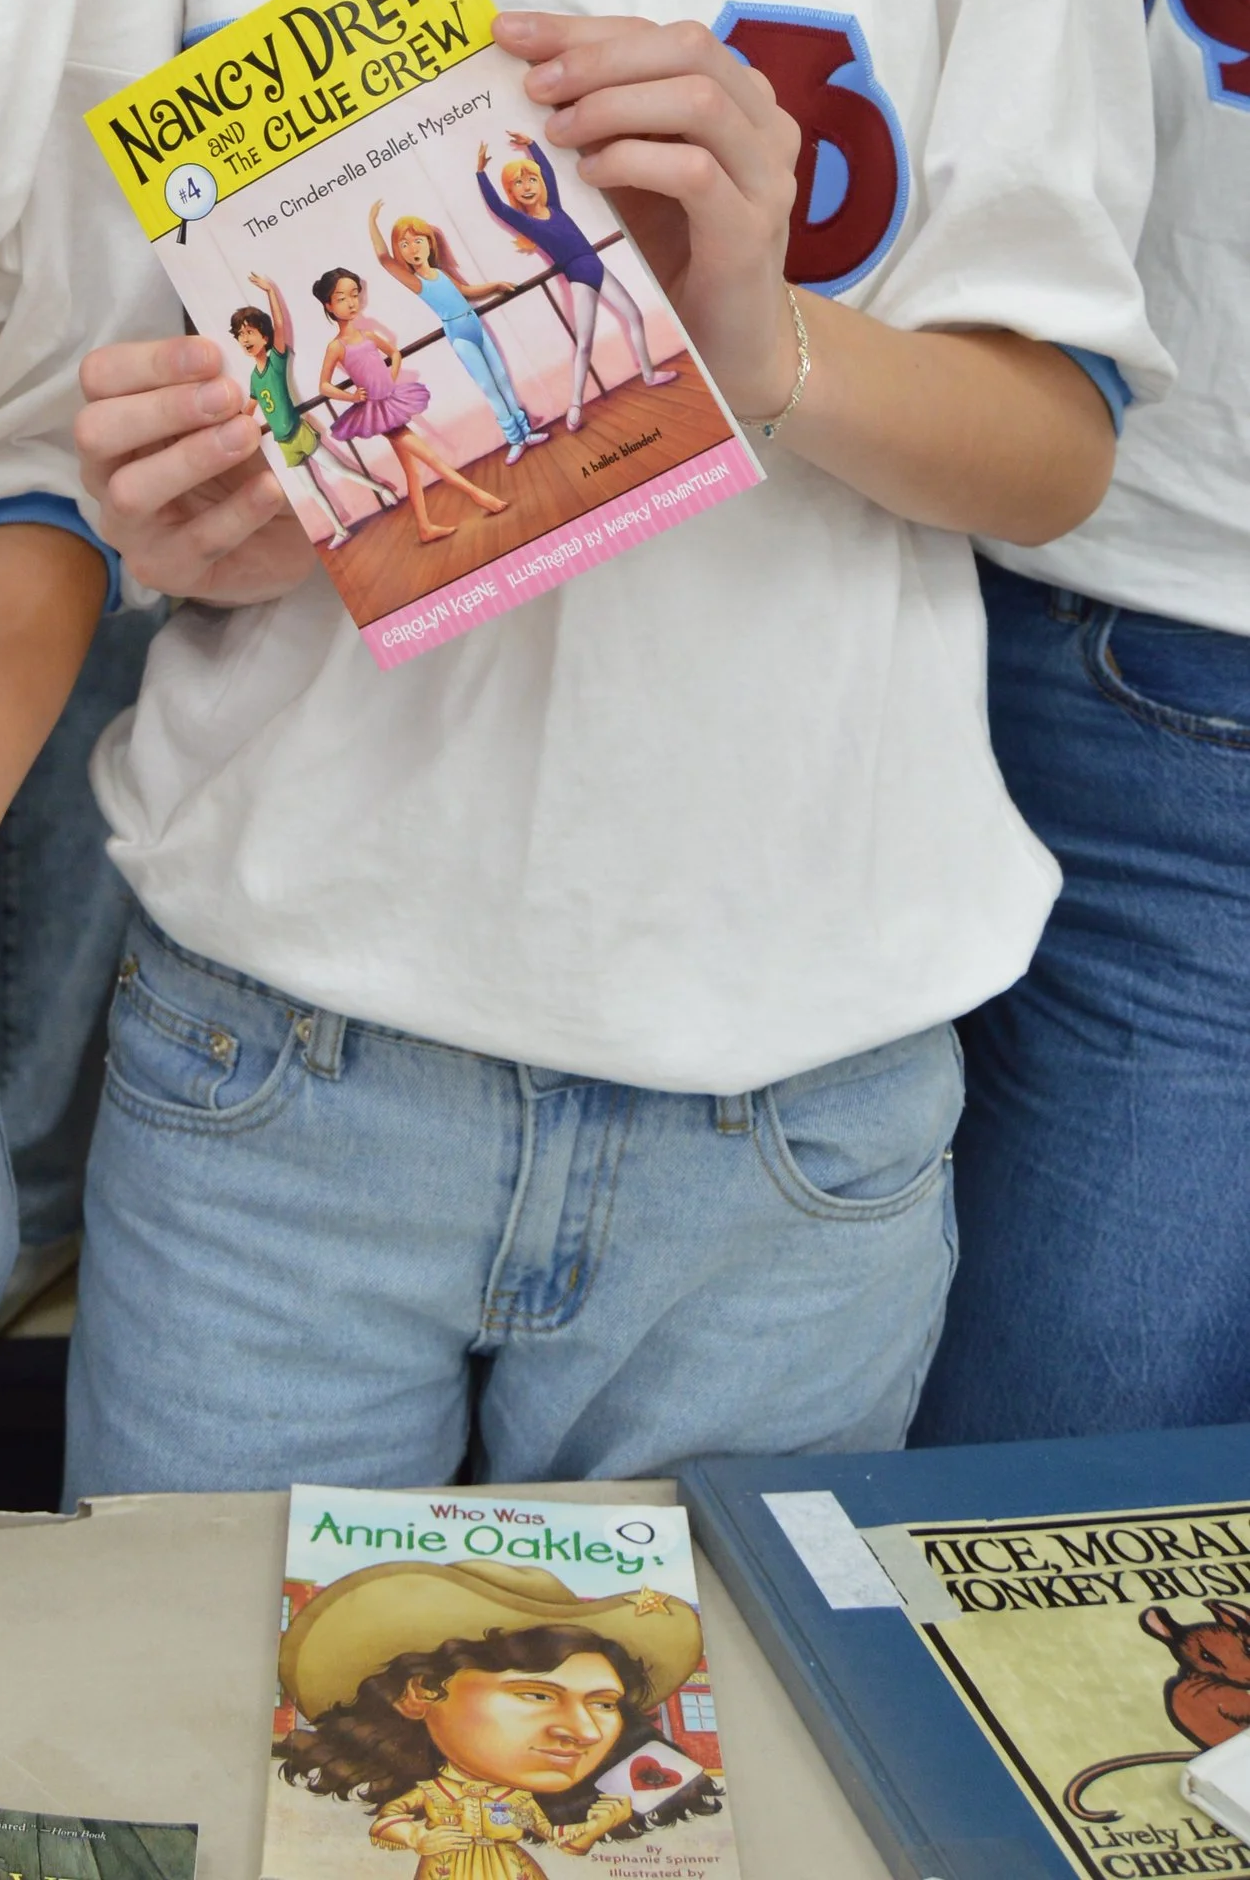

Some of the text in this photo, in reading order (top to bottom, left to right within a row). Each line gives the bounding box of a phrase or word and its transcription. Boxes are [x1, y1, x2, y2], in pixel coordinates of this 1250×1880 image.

[263, 82, 359, 153] CLUE
[361, 1, 470, 97] CREW
[243, 89, 493, 238] The Cinderella Ballet Mystery
[179, 177, 201, 204] #4
[260, 388, 276, 414] 3
[581, 427, 662, 479] A ballet blunder!
[449, 581, 499, 616] KEENE
[430, 1504, 546, 1526] Who Was
[310, 1511, 448, 1553] Annie
[80, 1829, 108, 1841] Book
[1080, 1822, 1180, 1851] Lively
[591, 1853, 721, 1865] Stephanie Spinner
[645, 1844, 663, 1856] By
[609, 1868, 706, 1880] Illustrated by
